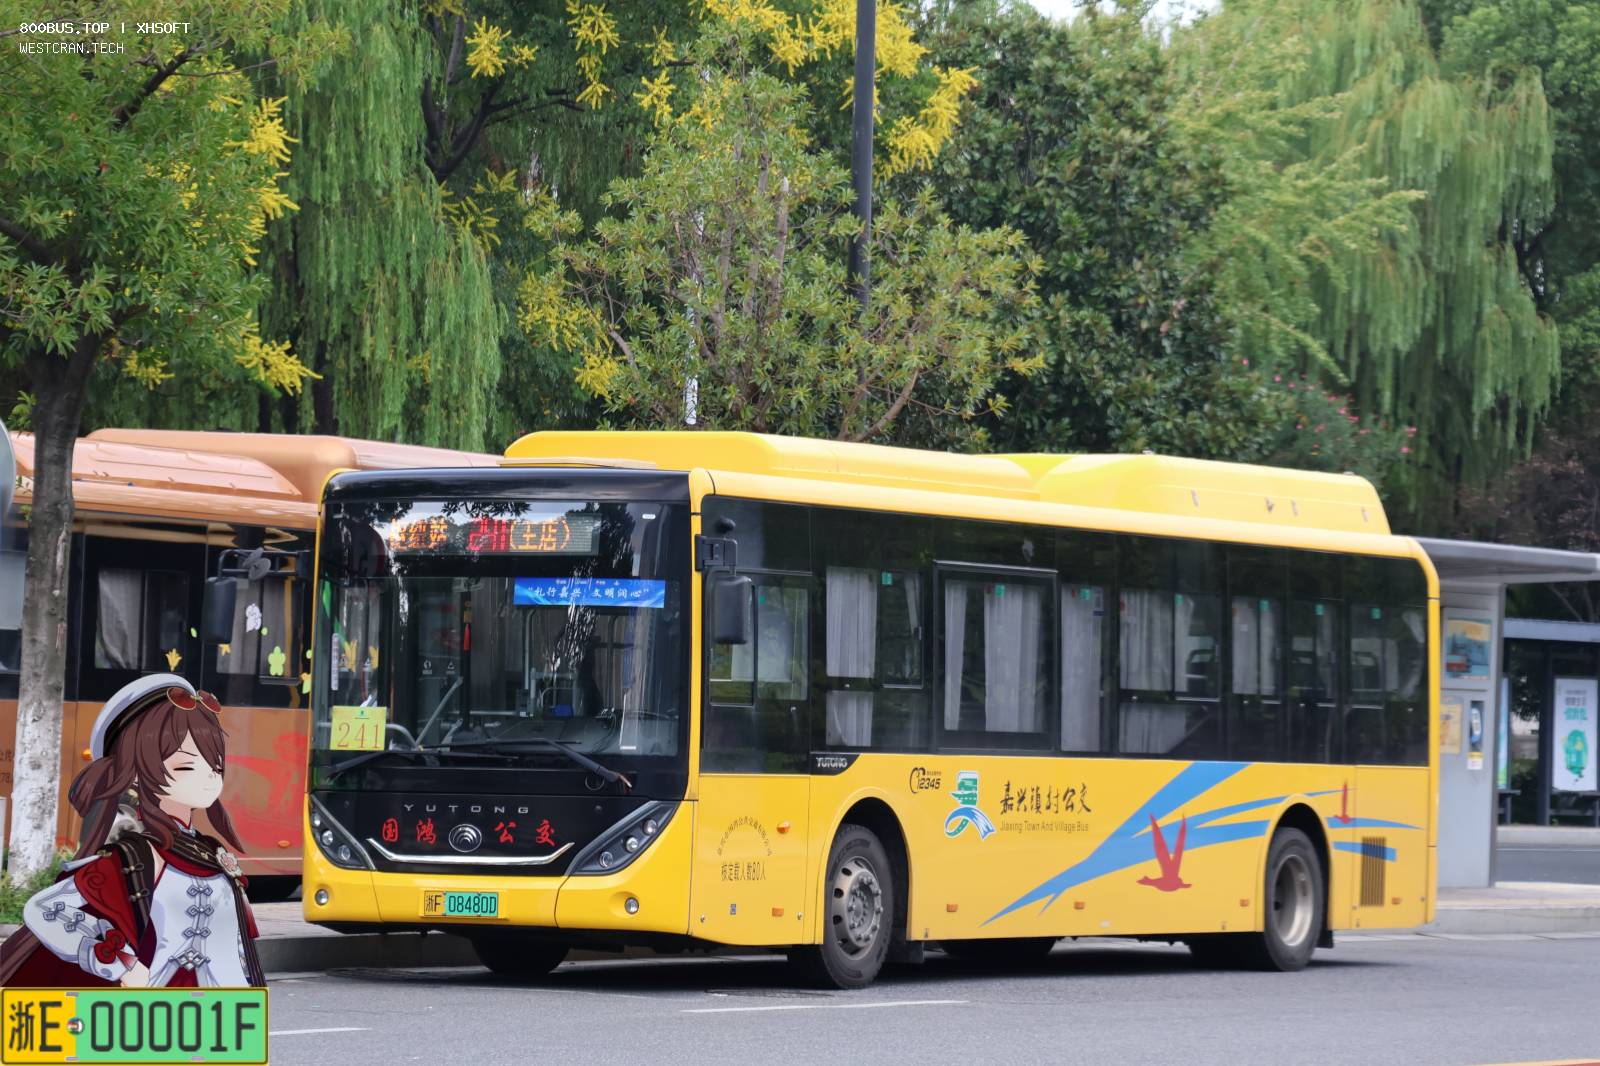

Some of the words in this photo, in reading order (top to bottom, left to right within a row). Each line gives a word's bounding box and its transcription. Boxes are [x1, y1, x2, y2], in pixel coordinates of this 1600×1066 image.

[337, 722, 380, 749] 241
[815, 757, 848, 768] YUTONG
[917, 777, 941, 790] 12345
[404, 804, 529, 814] YUTONG
[1024, 820, 1040, 831] Town
[1040, 821, 1053, 831] And
[1055, 820, 1077, 833] Village
[1077, 821, 1089, 831] Bus
[448, 895, 496, 914] 08480D
